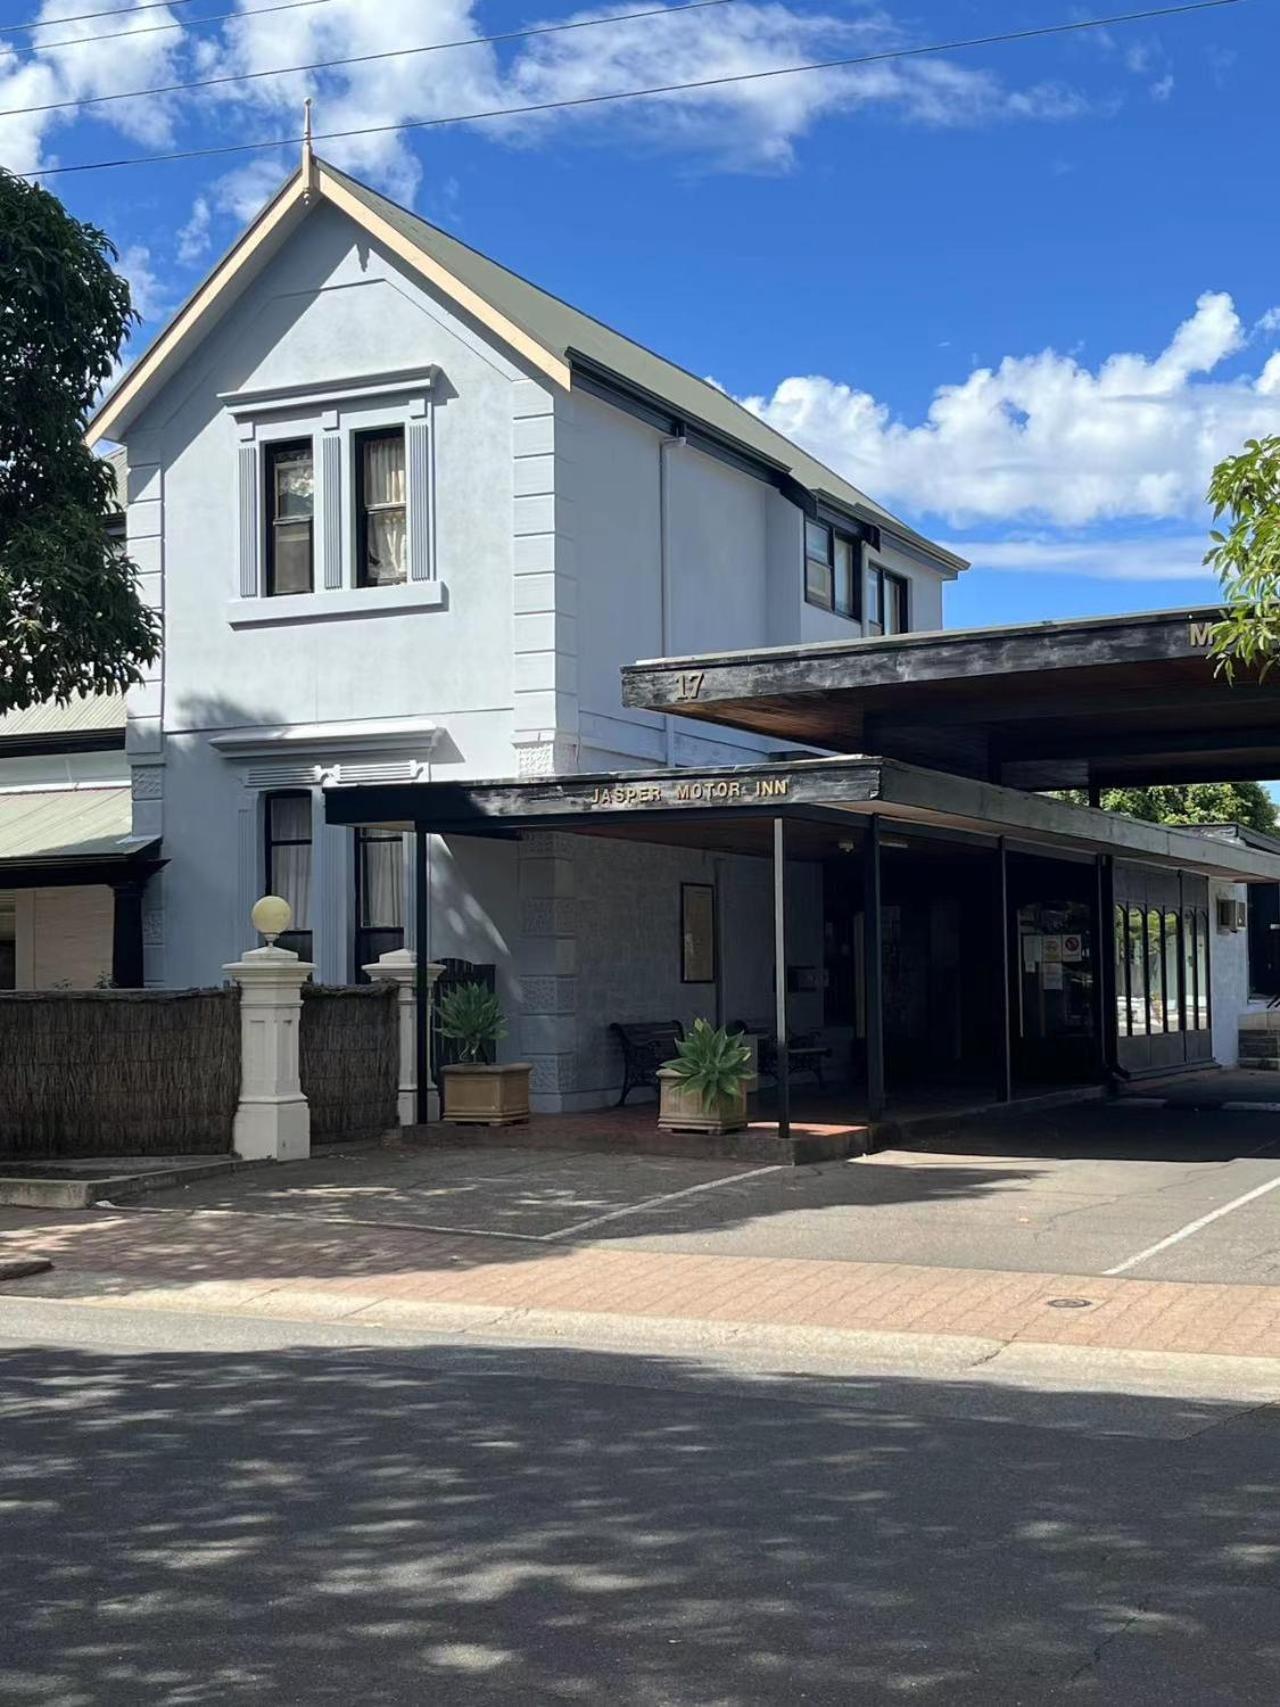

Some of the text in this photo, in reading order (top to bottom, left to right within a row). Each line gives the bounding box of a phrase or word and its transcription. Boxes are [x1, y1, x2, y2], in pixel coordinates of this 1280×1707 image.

[675, 671, 704, 699] 17
[593, 780, 788, 804] JASPER MOTOR INN
